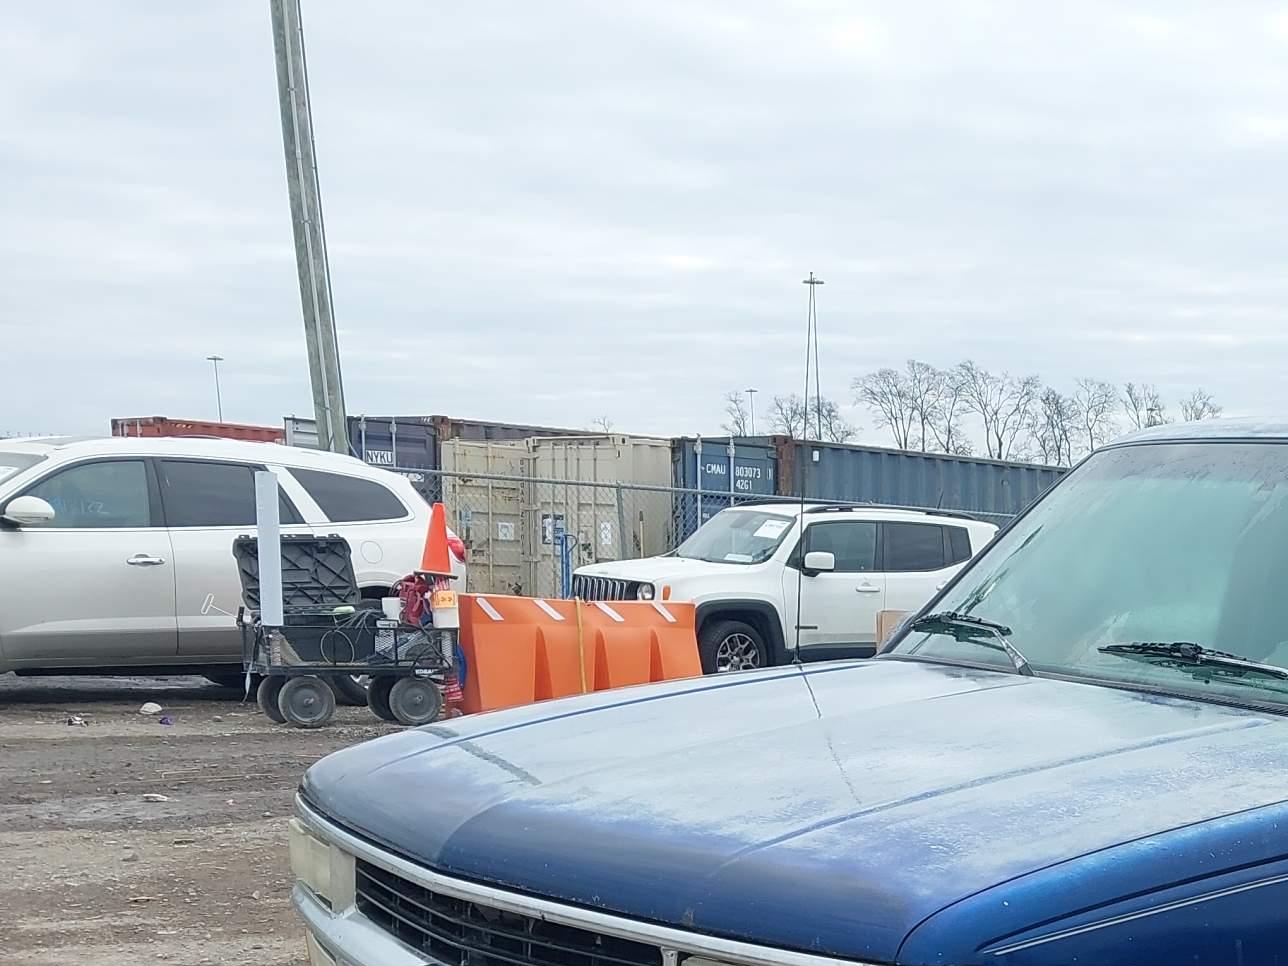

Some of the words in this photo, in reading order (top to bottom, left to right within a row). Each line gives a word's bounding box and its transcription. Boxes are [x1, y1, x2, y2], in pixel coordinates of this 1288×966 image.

[366, 450, 393, 464] NYKU
[706, 463, 726, 475] CMAU
[735, 466, 760, 479] 803073
[735, 479, 752, 490] 42G1
